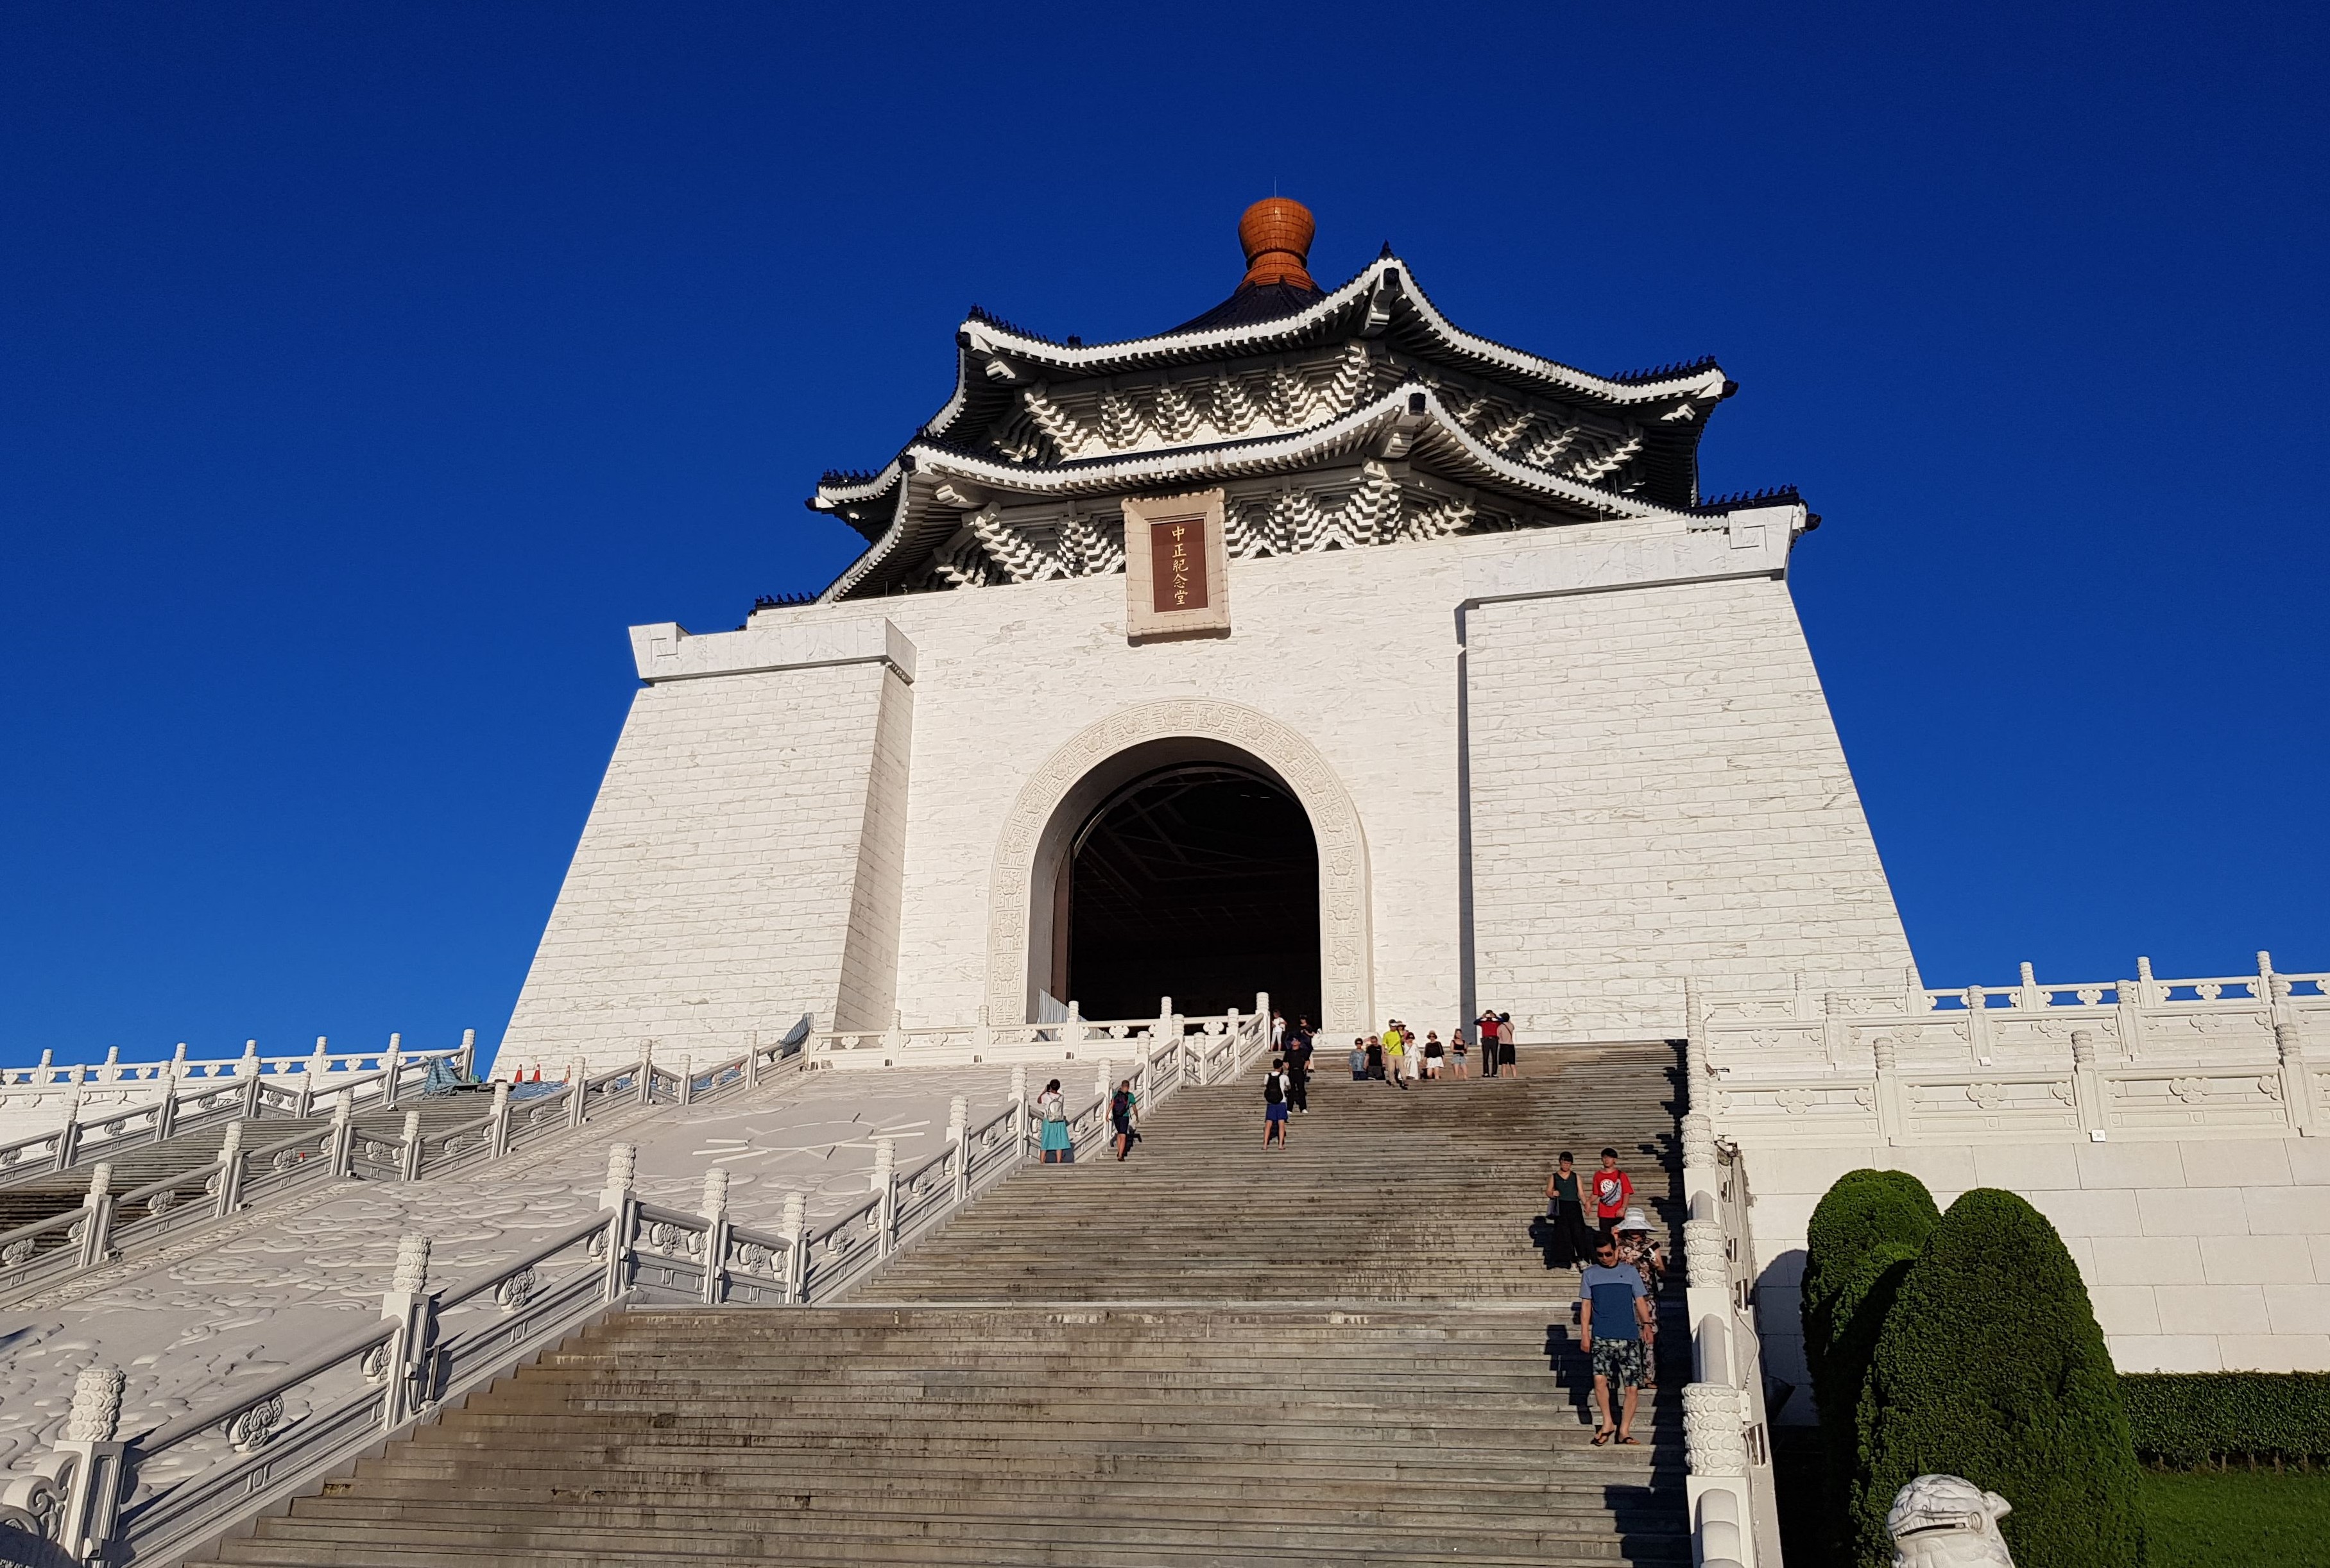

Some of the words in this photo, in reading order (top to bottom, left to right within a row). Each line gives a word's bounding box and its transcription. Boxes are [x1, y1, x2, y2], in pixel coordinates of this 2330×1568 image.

[1172, 526, 1188, 605] 中正紀念堂
